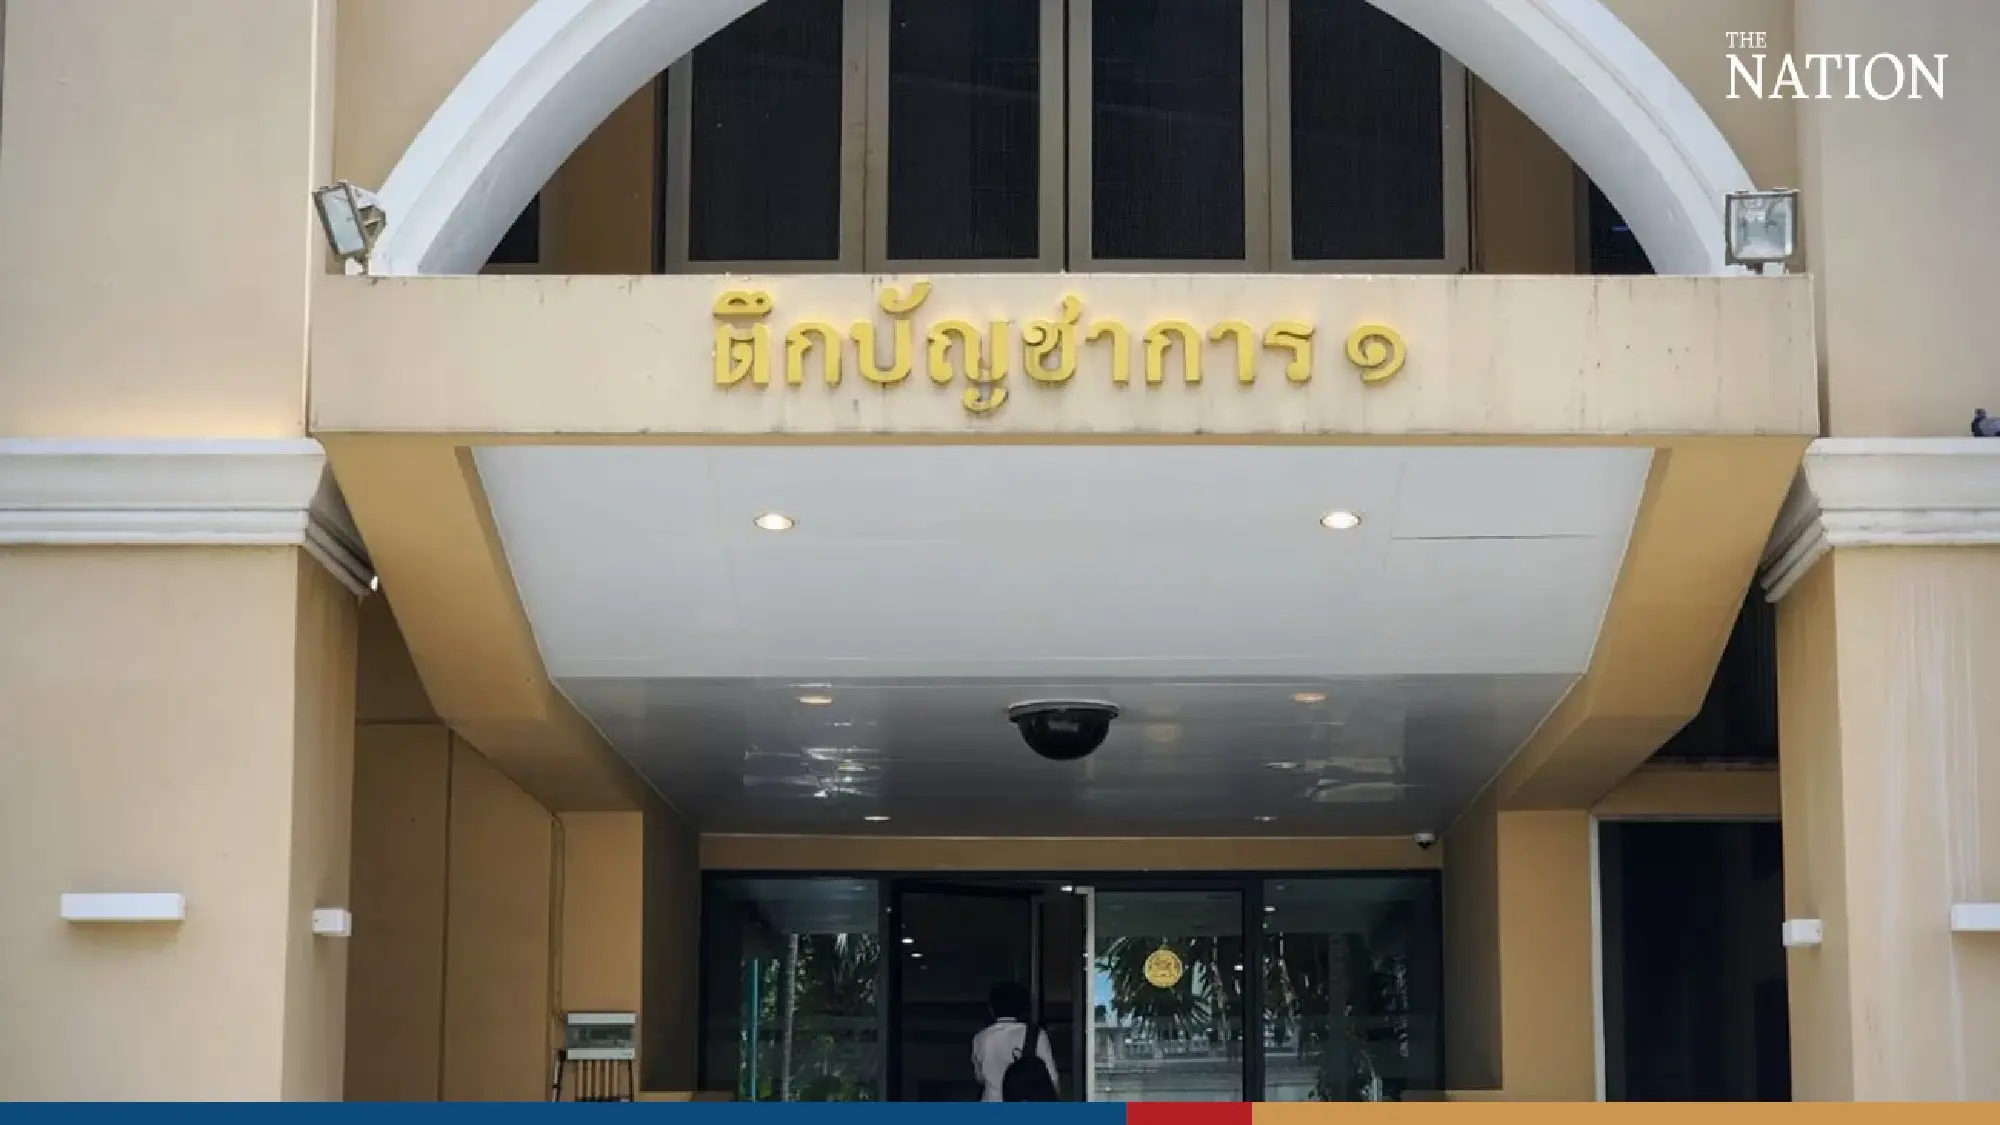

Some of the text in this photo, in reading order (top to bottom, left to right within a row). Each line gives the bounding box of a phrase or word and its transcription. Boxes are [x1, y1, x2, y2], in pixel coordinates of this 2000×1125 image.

[712, 281, 1409, 413] ตึกบัญชาการ ๑
